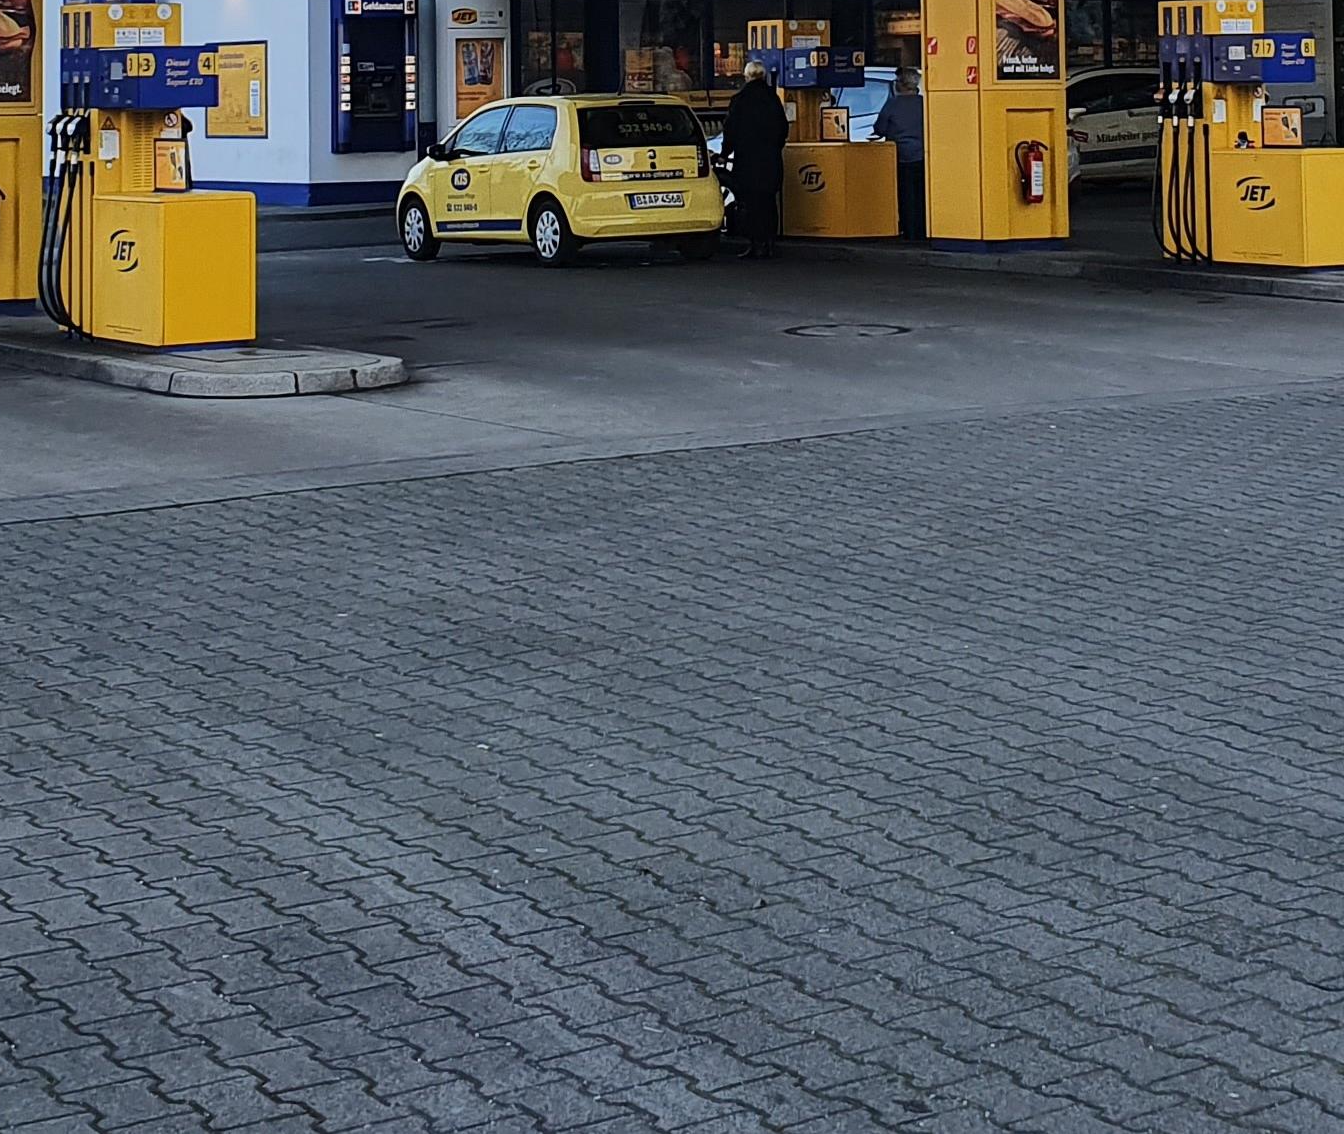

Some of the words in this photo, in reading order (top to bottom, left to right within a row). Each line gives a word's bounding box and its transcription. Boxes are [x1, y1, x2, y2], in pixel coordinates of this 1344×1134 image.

[1265, 43, 1272, 54] 7
[142, 58, 151, 72] 3
[202, 56, 211, 71] 4
[454, 173, 468, 186] KIS
[1240, 185, 1271, 202] JET
[112, 240, 136, 262] JET
